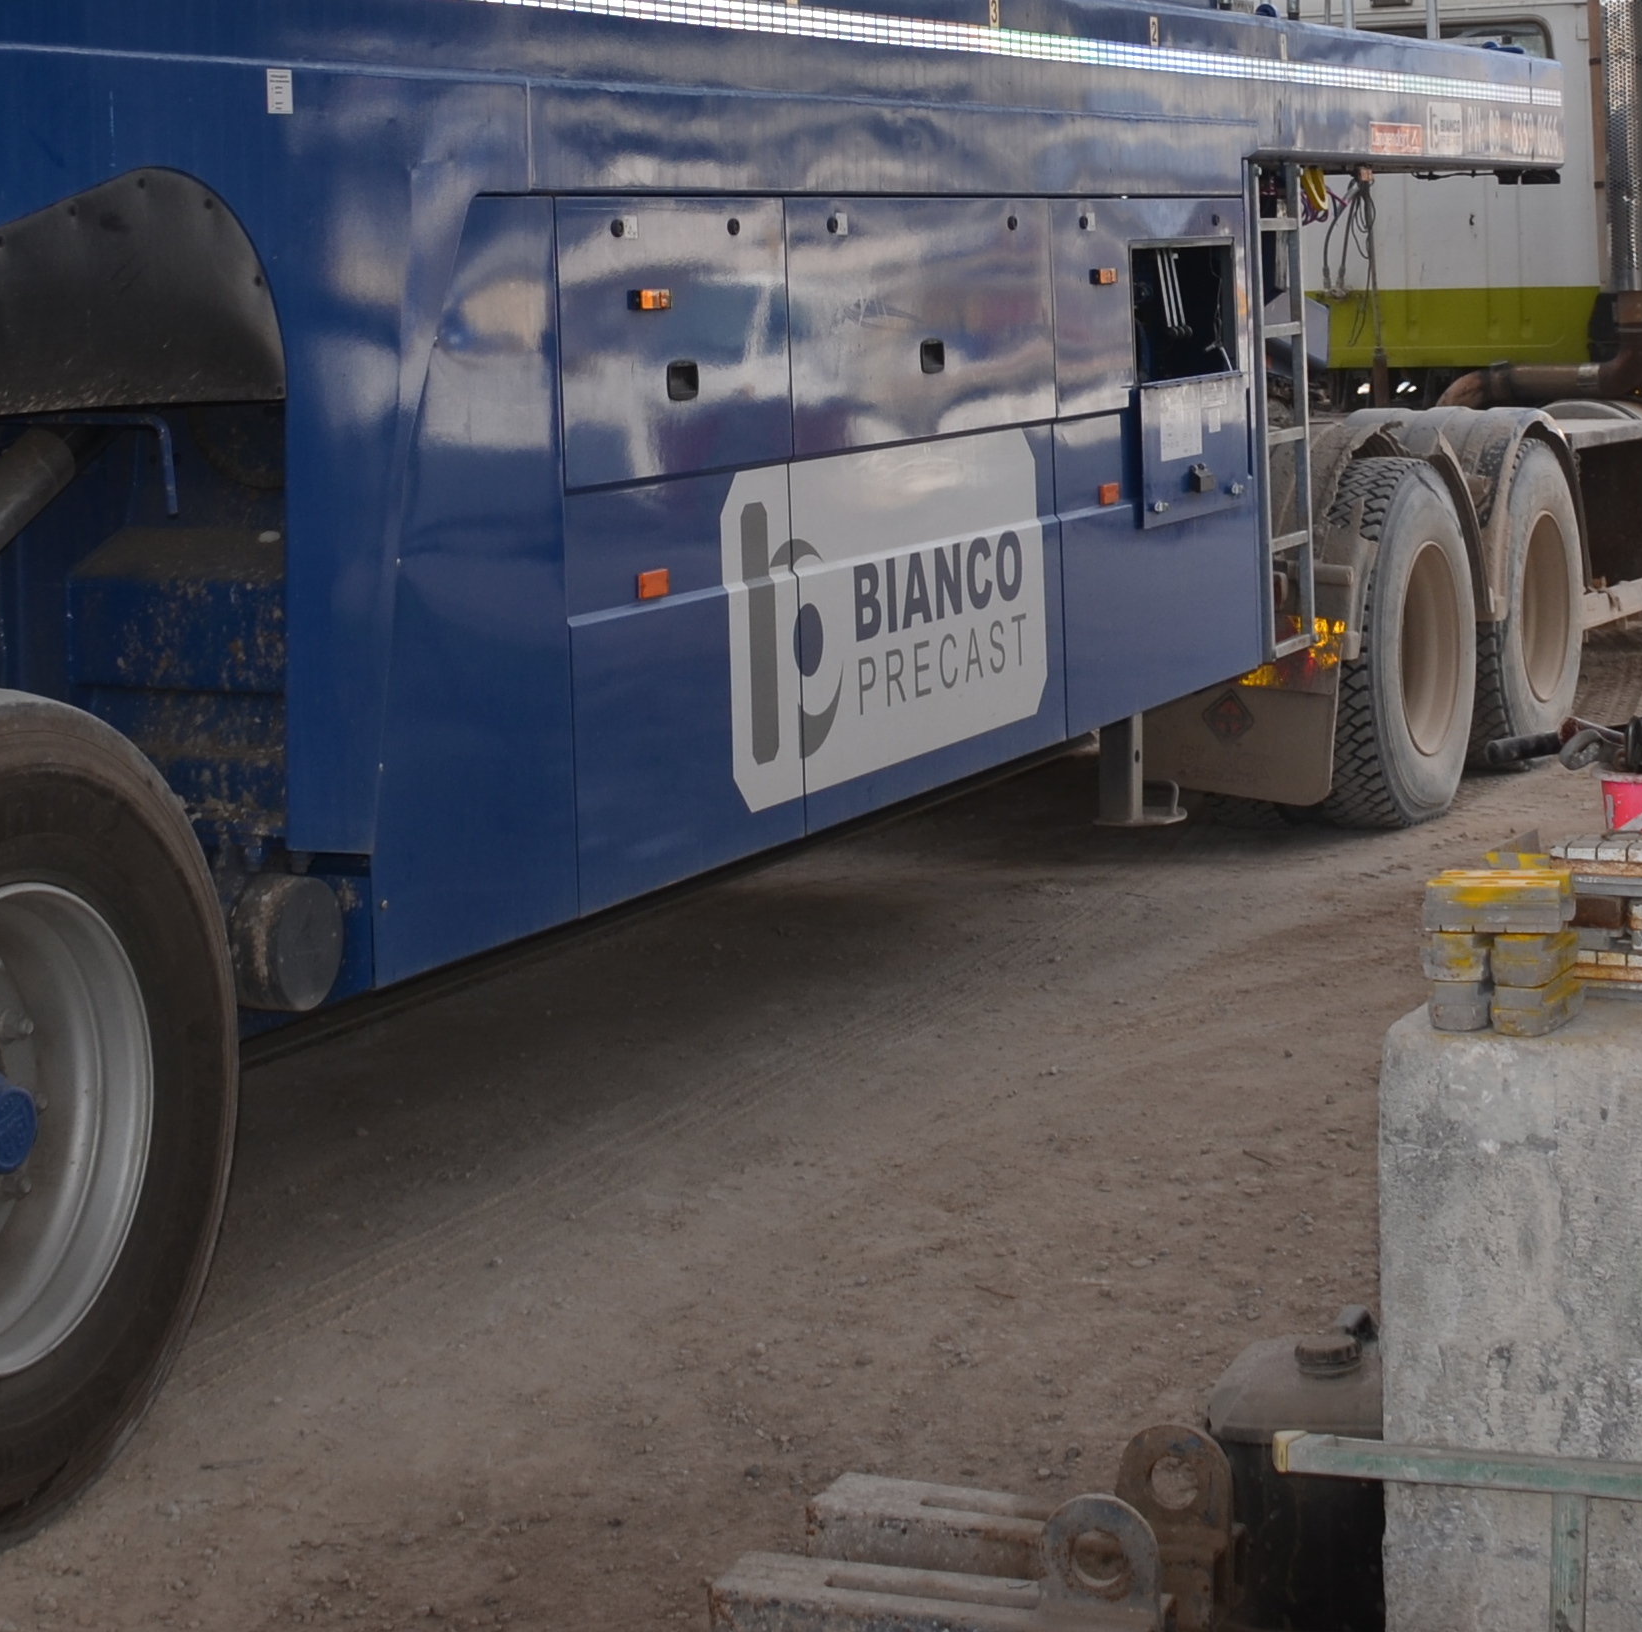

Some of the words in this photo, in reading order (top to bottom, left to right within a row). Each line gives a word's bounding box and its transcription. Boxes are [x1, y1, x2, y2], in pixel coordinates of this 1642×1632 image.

[991, 0, 998, 23] 3
[1152, 21, 1157, 42] 2
[853, 530, 1022, 642] BIANCO
[858, 613, 1026, 715] PRECAST
